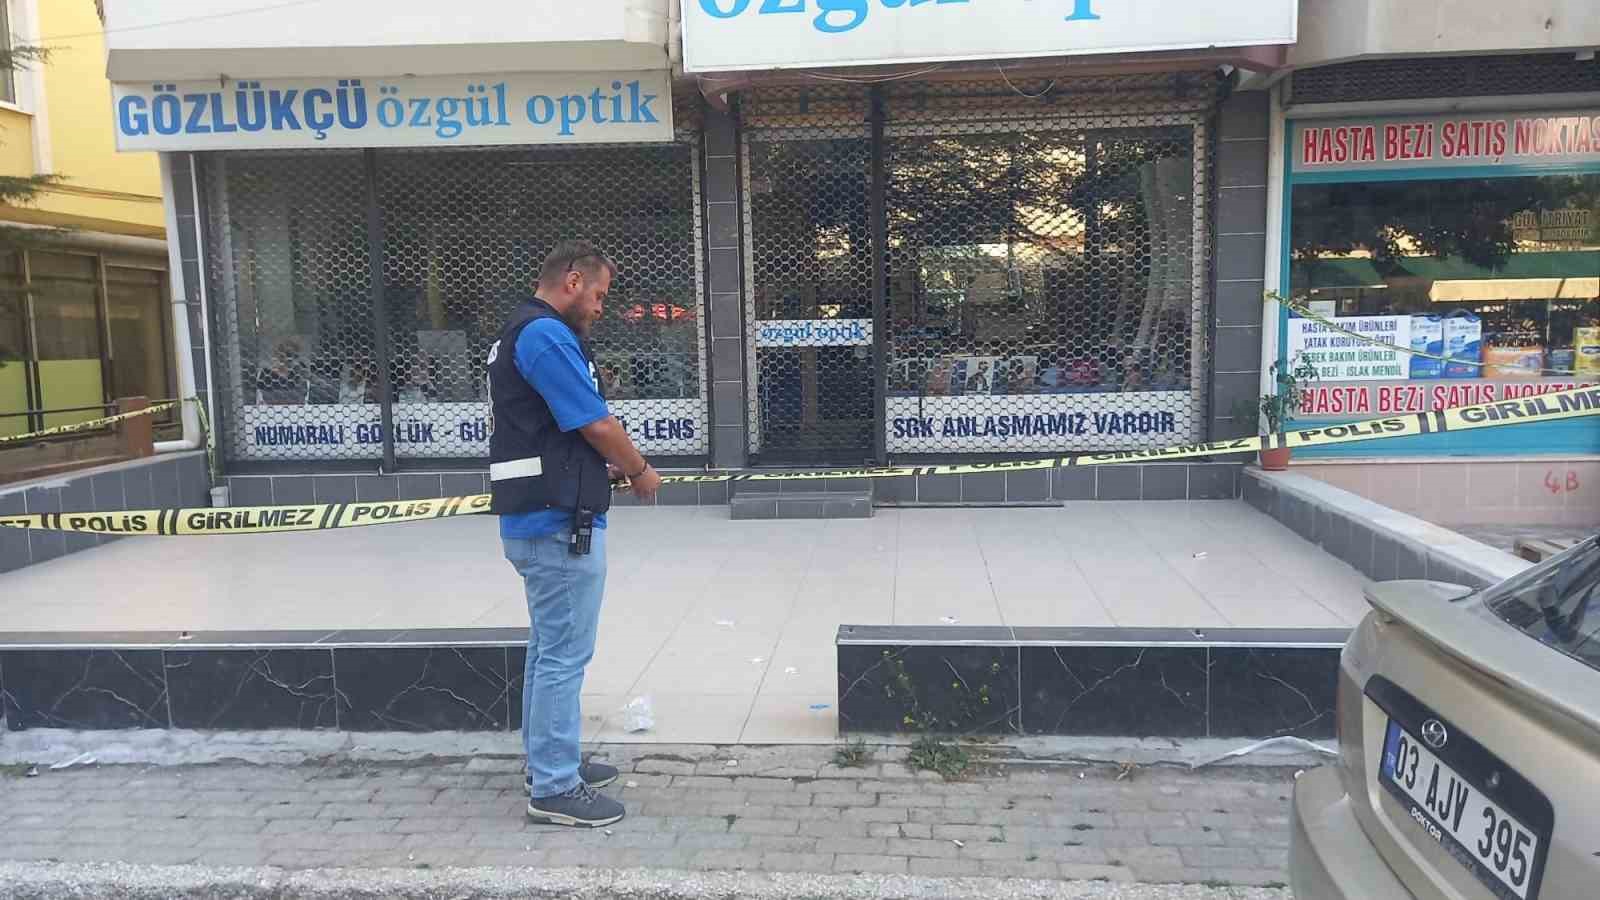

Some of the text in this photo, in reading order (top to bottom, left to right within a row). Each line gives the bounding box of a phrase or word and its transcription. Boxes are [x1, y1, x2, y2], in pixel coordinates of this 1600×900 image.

[118, 79, 660, 141] GÖZLÜKÇÜ özgül optik
[1303, 125, 1376, 164] HASTA
[1441, 119, 1507, 162] SATIŞ
[1330, 321, 1357, 332] AKIM
[1304, 337, 1328, 349] YATAK
[1329, 350, 1355, 362] BAKIM
[1302, 385, 1369, 413] HASTA
[256, 423, 344, 446] NUMARALI
[356, 418, 433, 444] GÖLÜK
[644, 419, 694, 440] LENS
[893, 410, 1176, 440] SGK ANLAŞMAMIZ VARDIR
[1396, 736, 1420, 790] 03
[1425, 763, 1469, 833] AJV
[1478, 807, 1531, 888] 395
